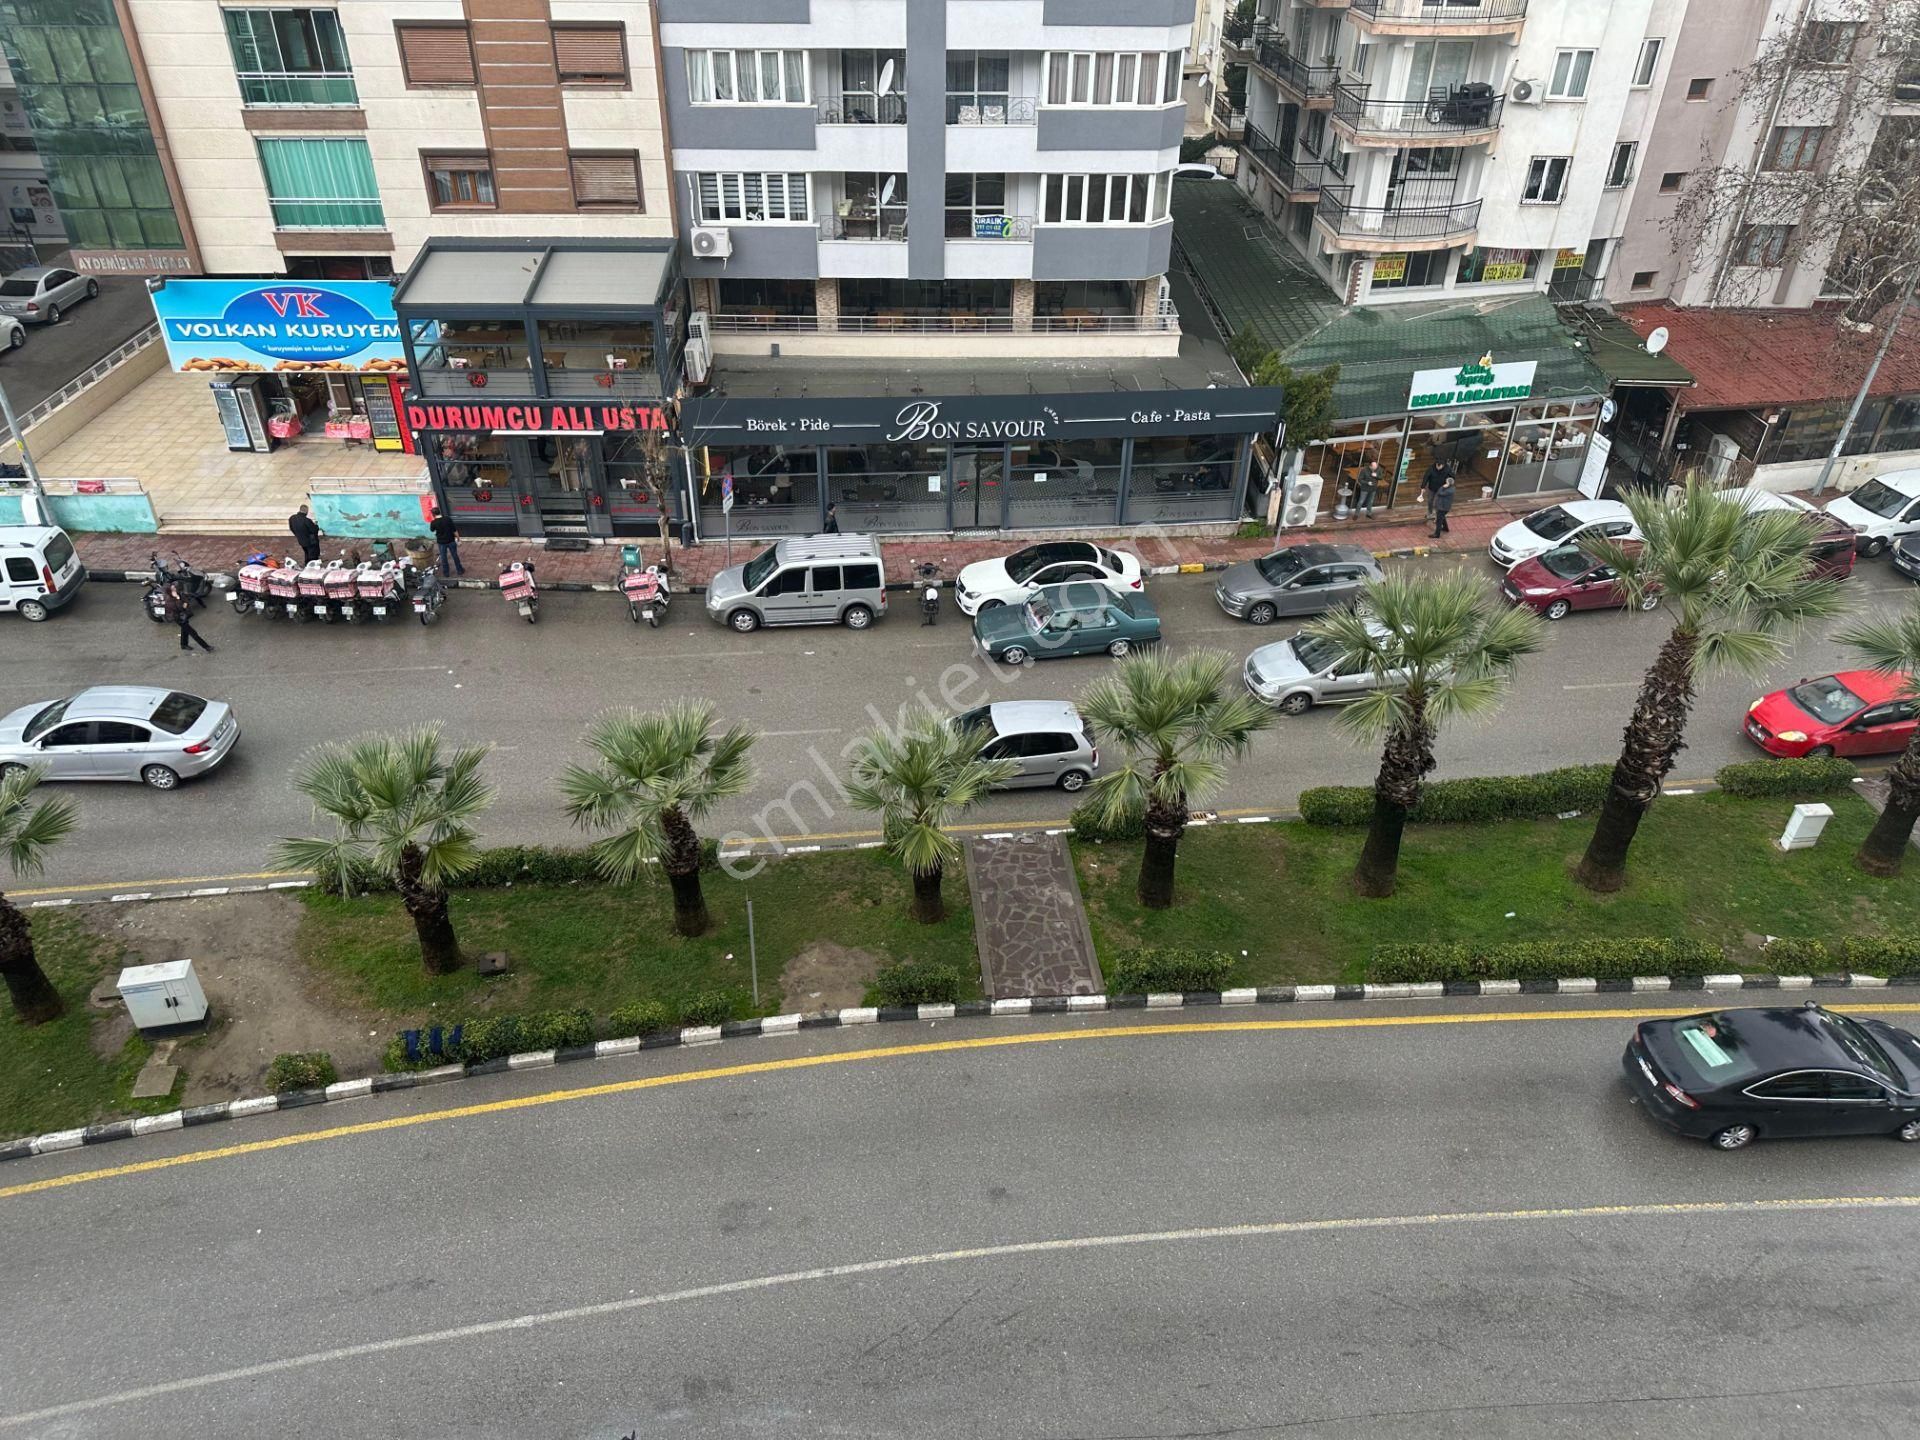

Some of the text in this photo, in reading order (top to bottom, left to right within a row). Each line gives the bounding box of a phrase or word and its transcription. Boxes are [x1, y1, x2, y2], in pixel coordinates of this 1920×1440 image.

[1374, 259, 1405, 271] KIRALIK
[1486, 248, 1528, 266] KIRALIK
[261, 292, 330, 318] VK
[175, 322, 277, 338] VOLKAN
[1411, 384, 1531, 408] ESNAF LOKANTASI
[408, 406, 669, 431] DURUMCU ALI USTA
[746, 418, 788, 432] Börek
[800, 418, 831, 432] Pide
[886, 401, 1047, 442] BON SAVOUR
[1130, 410, 1163, 425] Cafe
[1173, 408, 1212, 423] Pasta
